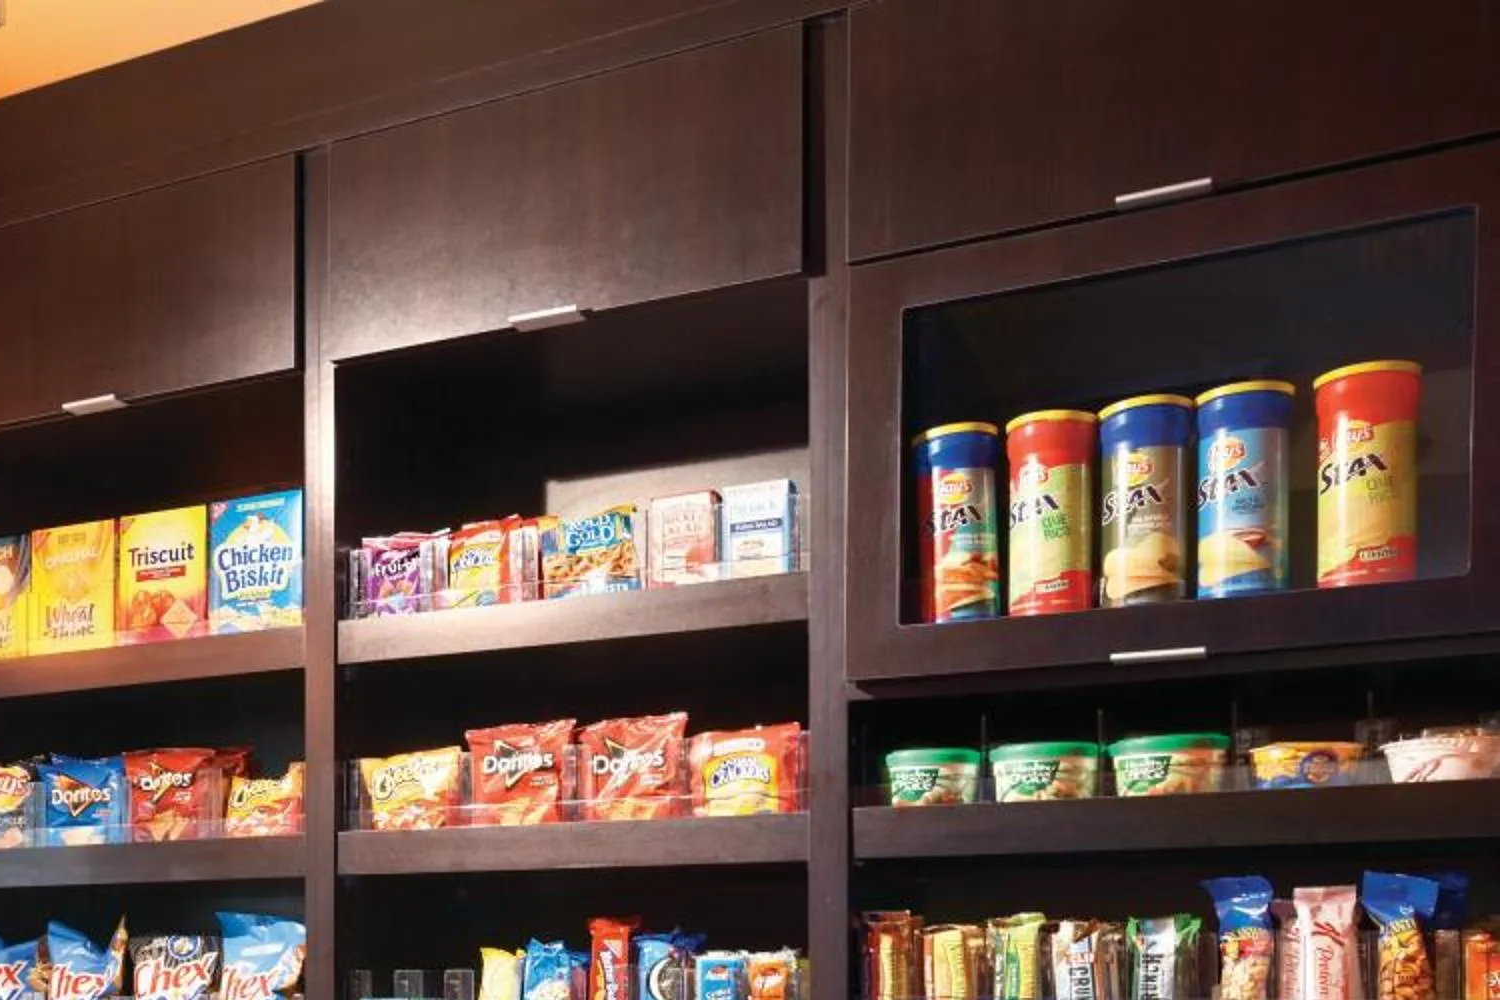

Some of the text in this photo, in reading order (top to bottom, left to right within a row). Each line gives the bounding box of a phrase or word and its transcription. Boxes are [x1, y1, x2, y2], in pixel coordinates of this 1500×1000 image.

[566, 525, 615, 547] GOLD
[127, 541, 195, 567] Triscuit
[217, 544, 293, 571] Chicken
[225, 564, 285, 593] Biskit
[483, 752, 554, 774] Doritos
[51, 787, 111, 806] Doritos
[134, 953, 214, 997] Chex
